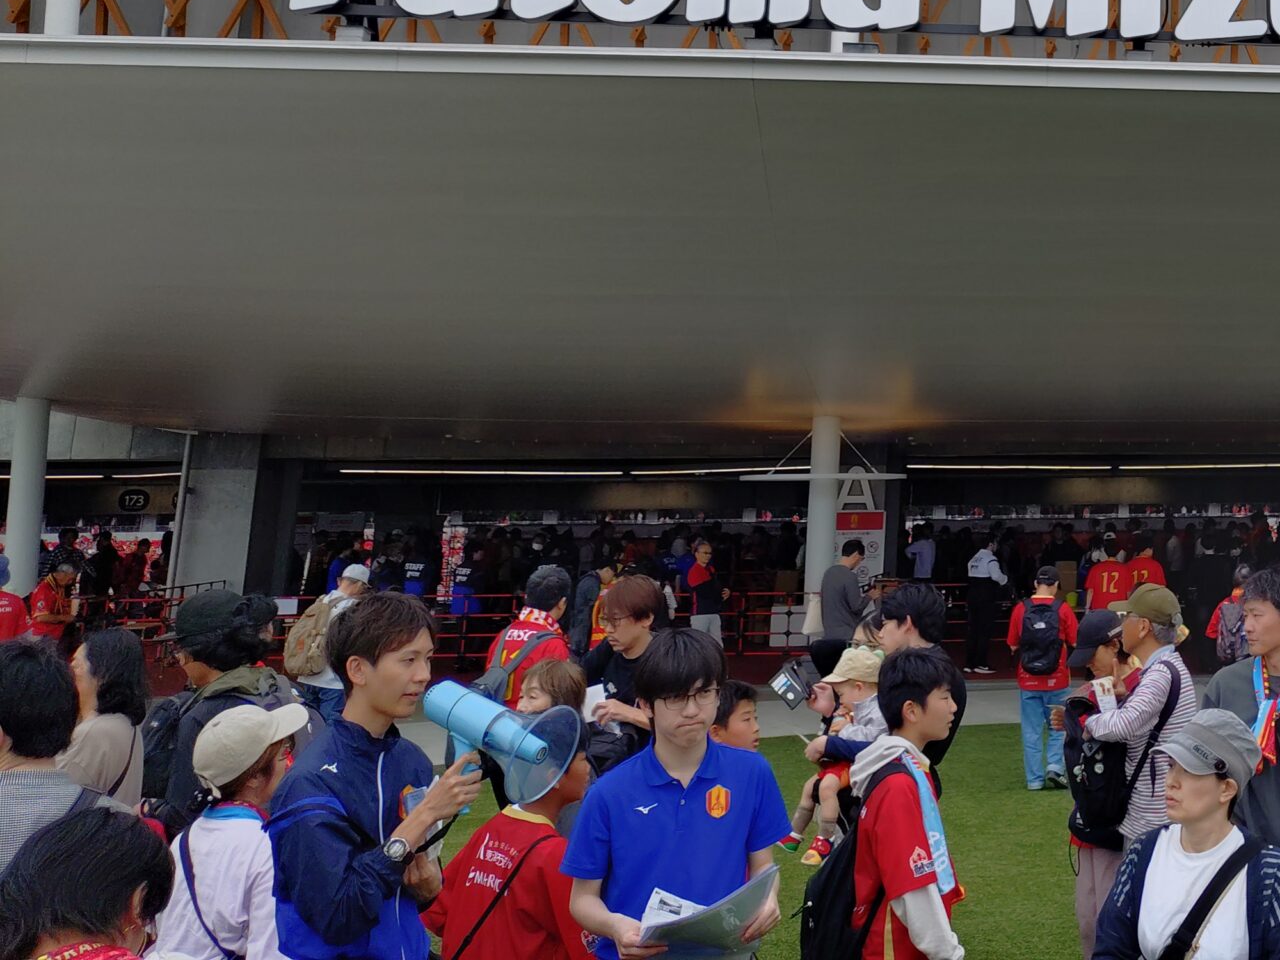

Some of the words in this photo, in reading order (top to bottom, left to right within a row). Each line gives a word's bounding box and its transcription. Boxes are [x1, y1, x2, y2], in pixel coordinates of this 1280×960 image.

[837, 465, 876, 511] A
[124, 495, 145, 507] 173
[404, 563, 425, 571] STAFF
[1101, 571, 1120, 593] 12
